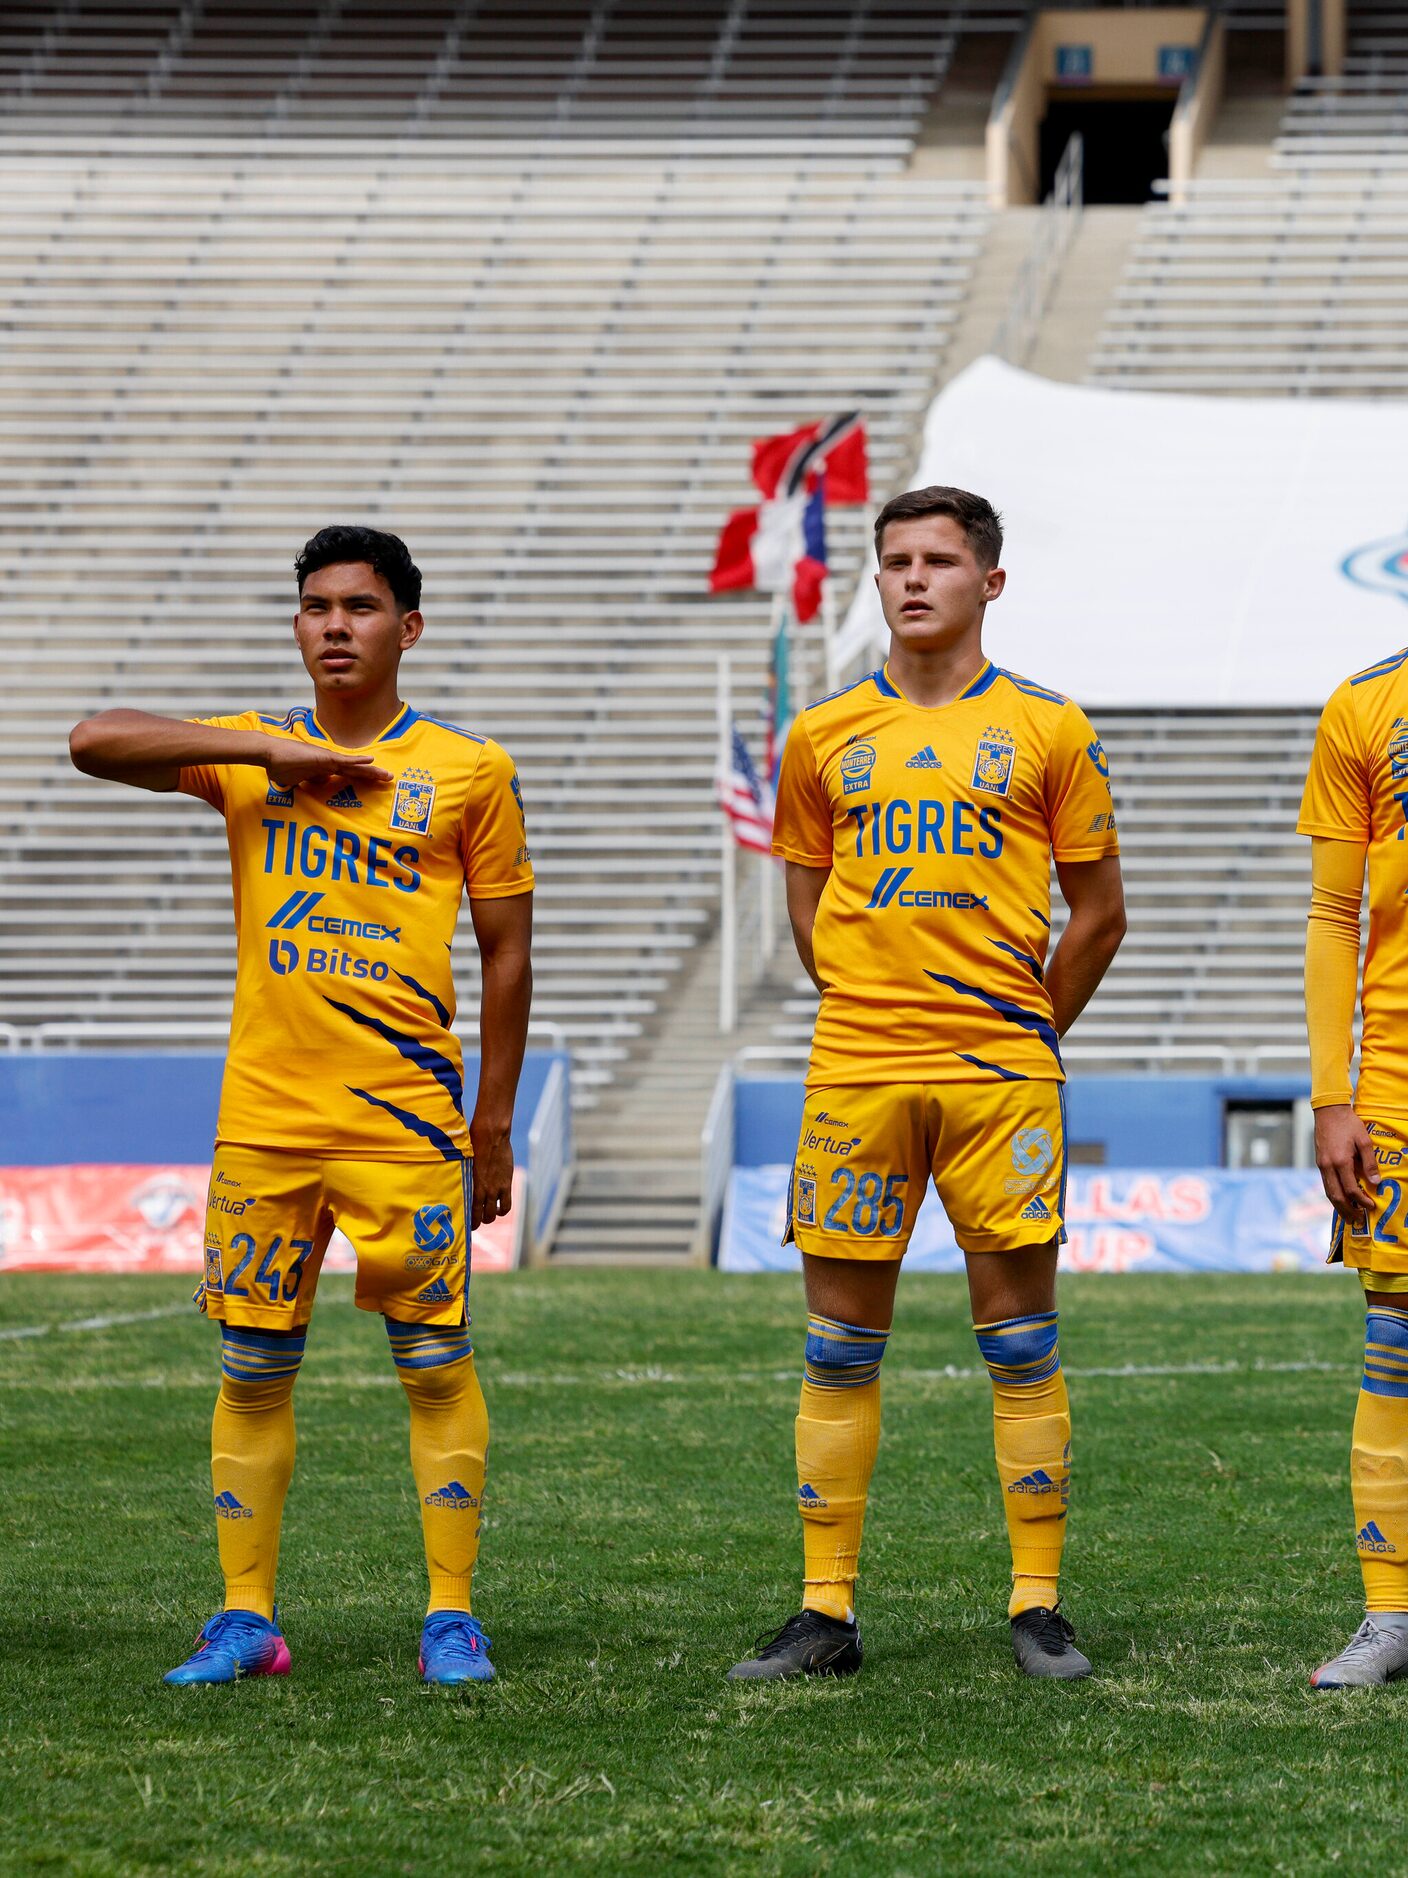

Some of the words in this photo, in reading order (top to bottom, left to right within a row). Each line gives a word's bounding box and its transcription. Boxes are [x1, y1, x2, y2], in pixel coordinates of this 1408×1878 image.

[979, 742, 1013, 755] TIGRES
[842, 754, 876, 768] MONTERREY
[905, 760, 942, 769] adidas
[399, 781, 433, 794] TIGRES
[844, 780, 868, 792] EXTRA
[979, 781, 1000, 792] UANL
[267, 794, 292, 805] EXTRA
[326, 799, 363, 808] adidas
[398, 820, 420, 830] UANL
[847, 799, 1004, 859] TIGRES
[262, 818, 421, 893] TIGRES
[898, 890, 989, 911] CEMEX
[307, 915, 401, 943] CEMEX
[306, 948, 389, 981] Bitso
[803, 1127, 853, 1156] Vertua
[1373, 1146, 1402, 1165] tua
[209, 1188, 246, 1216] Vertua
[823, 1167, 909, 1237] 285
[1021, 1210, 1052, 1219] adidas
[224, 1232, 314, 1301] 243
[432, 1254, 458, 1266] GAS
[418, 1293, 453, 1302] adidas
[1008, 1484, 1059, 1495] adidas
[424, 1494, 477, 1508] adidas
